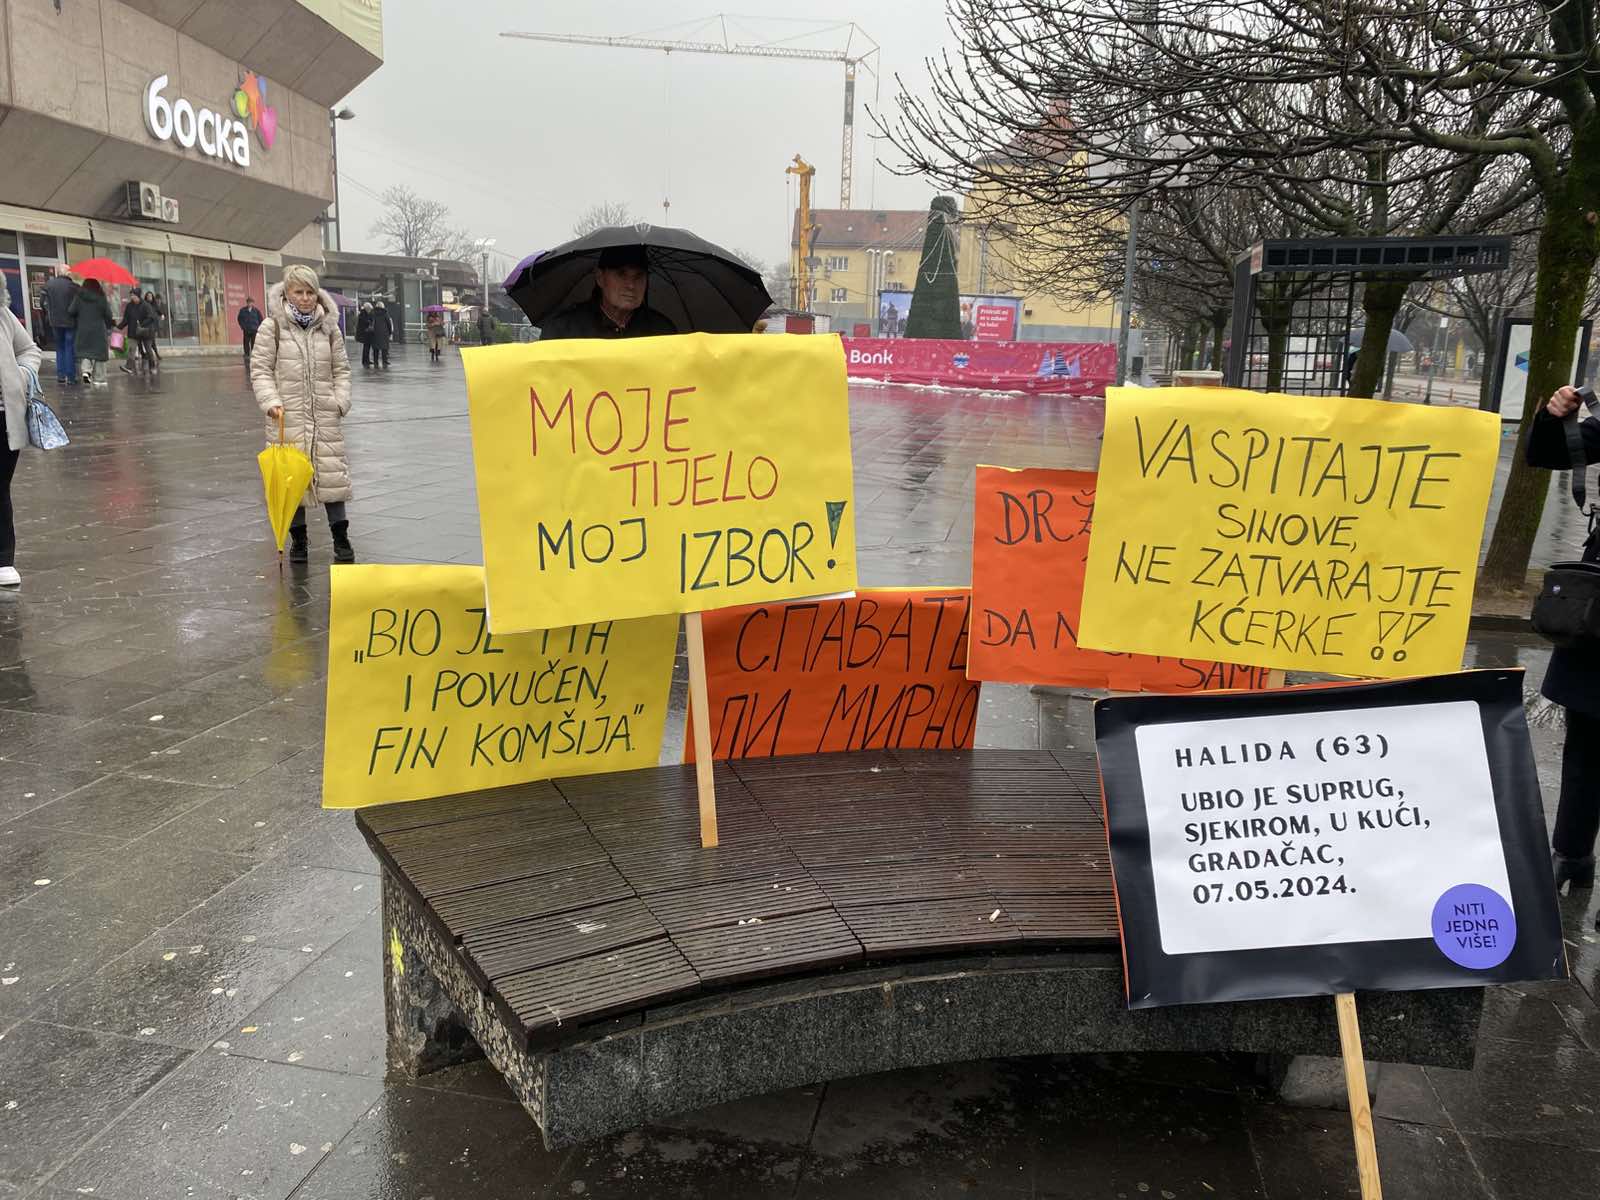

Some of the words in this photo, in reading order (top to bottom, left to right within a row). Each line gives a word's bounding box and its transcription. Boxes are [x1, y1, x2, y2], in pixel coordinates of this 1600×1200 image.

[850, 349, 893, 365] Bank
[530, 386, 697, 457] MOJE
[609, 450, 779, 507] TIJELO
[1134, 416, 1462, 510] VASPITAJTE
[537, 518, 647, 571] MOJ
[680, 501, 848, 594] IZBOR!
[1216, 504, 1359, 553] SINOVE,
[1114, 541, 1177, 585] NE
[1191, 547, 1461, 608] ZATVARAJTE
[979, 608, 1036, 650] DA
[1189, 596, 1357, 658] KĆERKE
[403, 675, 412, 713] I
[431, 659, 609, 710] POVUČEN,
[816, 683, 979, 753] МИРНО
[368, 725, 448, 776] FIN
[1175, 740, 1296, 768] HALIDA
[1315, 733, 1389, 763] (63)
[1180, 788, 1245, 812] UBIO
[1253, 786, 1278, 812] JE
[1286, 777, 1405, 805] SUPRUG,
[1184, 814, 1321, 846] SJEKIROM,
[1329, 811, 1348, 832] U
[1357, 800, 1431, 831] KUĆI,
[1188, 840, 1345, 873] GRADAČAC,
[1192, 874, 1358, 904] 07.05.2024.
[1453, 903, 1486, 917] NITI
[1444, 918, 1500, 934] JEDNA
[1456, 932, 1498, 950] VIŠE!
